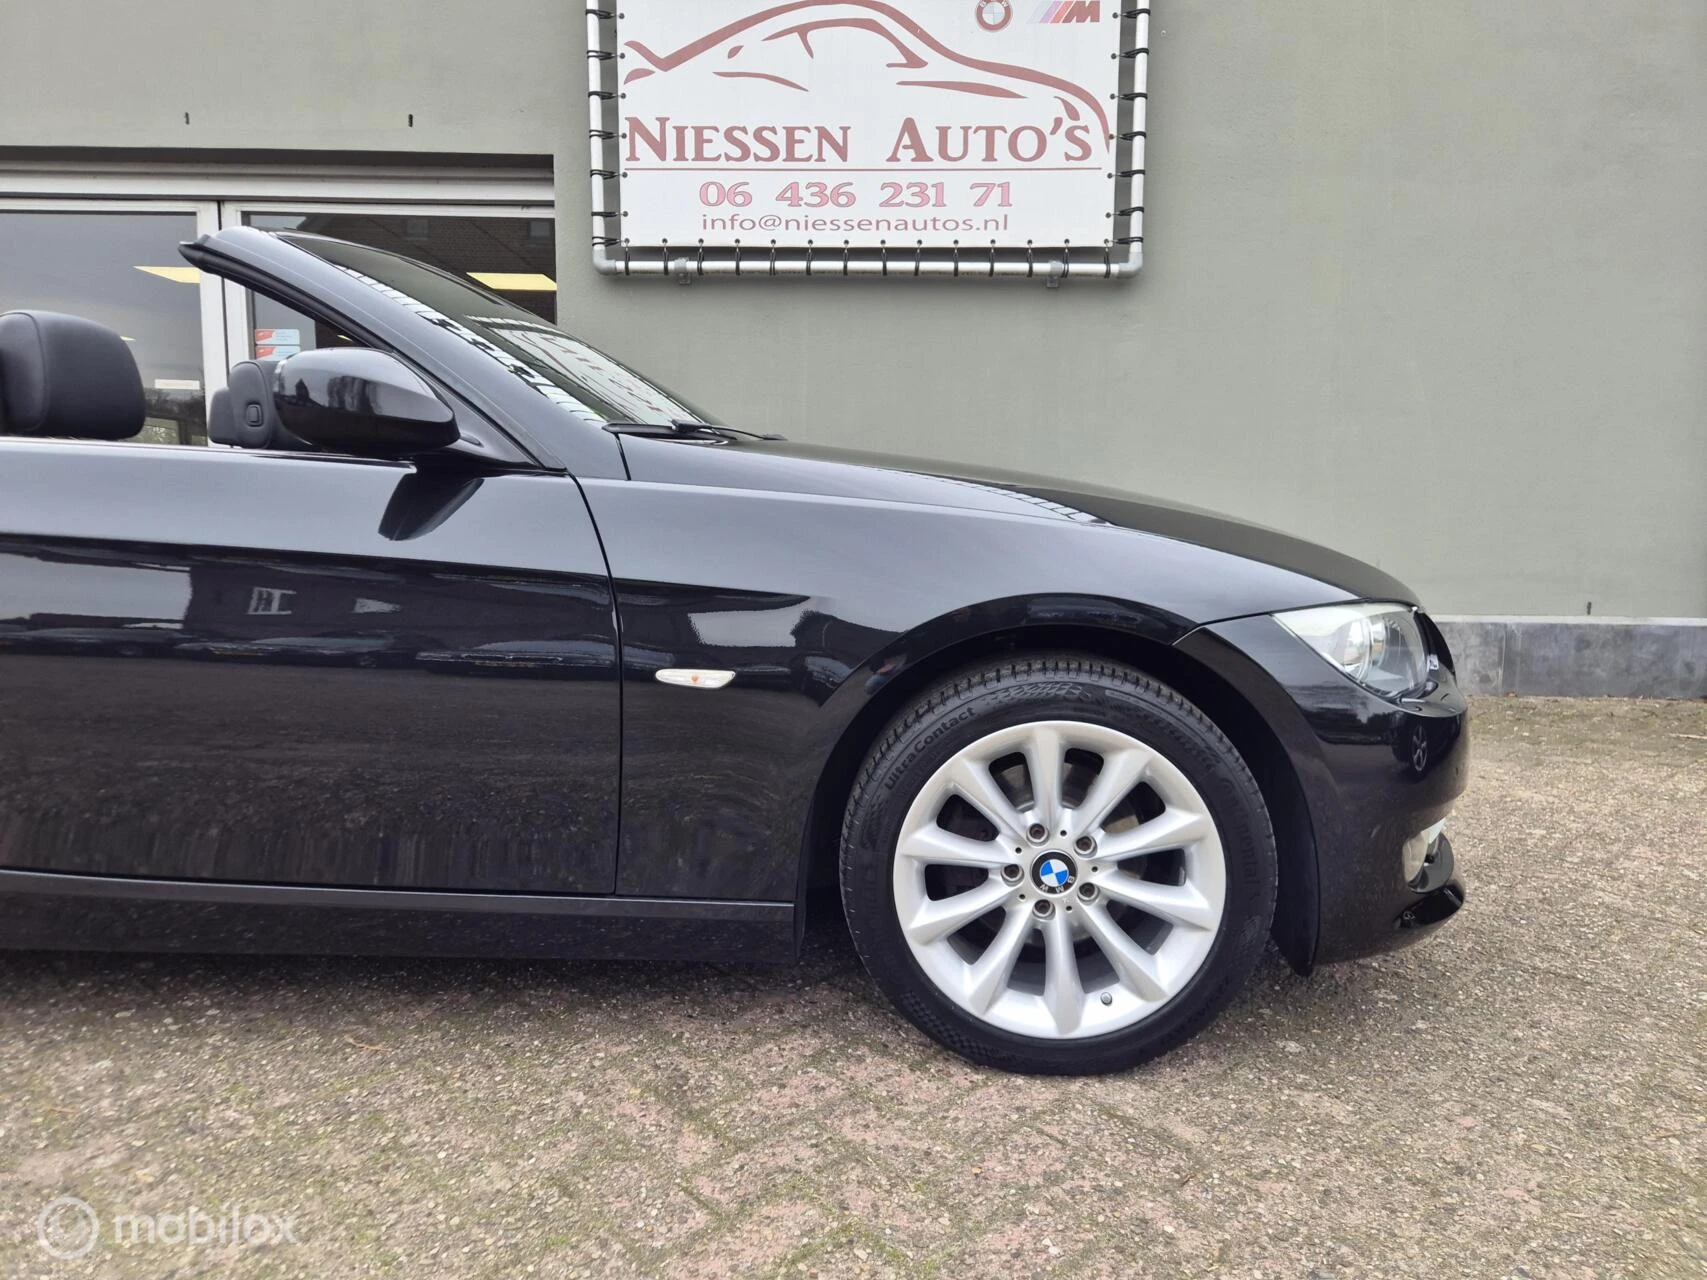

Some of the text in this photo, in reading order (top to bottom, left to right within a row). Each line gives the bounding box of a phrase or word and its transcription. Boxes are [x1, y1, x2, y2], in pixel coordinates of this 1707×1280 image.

[624, 116, 1092, 162] NIESSEN AUTO'S
[699, 182, 1012, 208] 06 436 231 71
[702, 214, 1008, 231] info@niessenautos.nl
[884, 707, 976, 790] UltraContact
